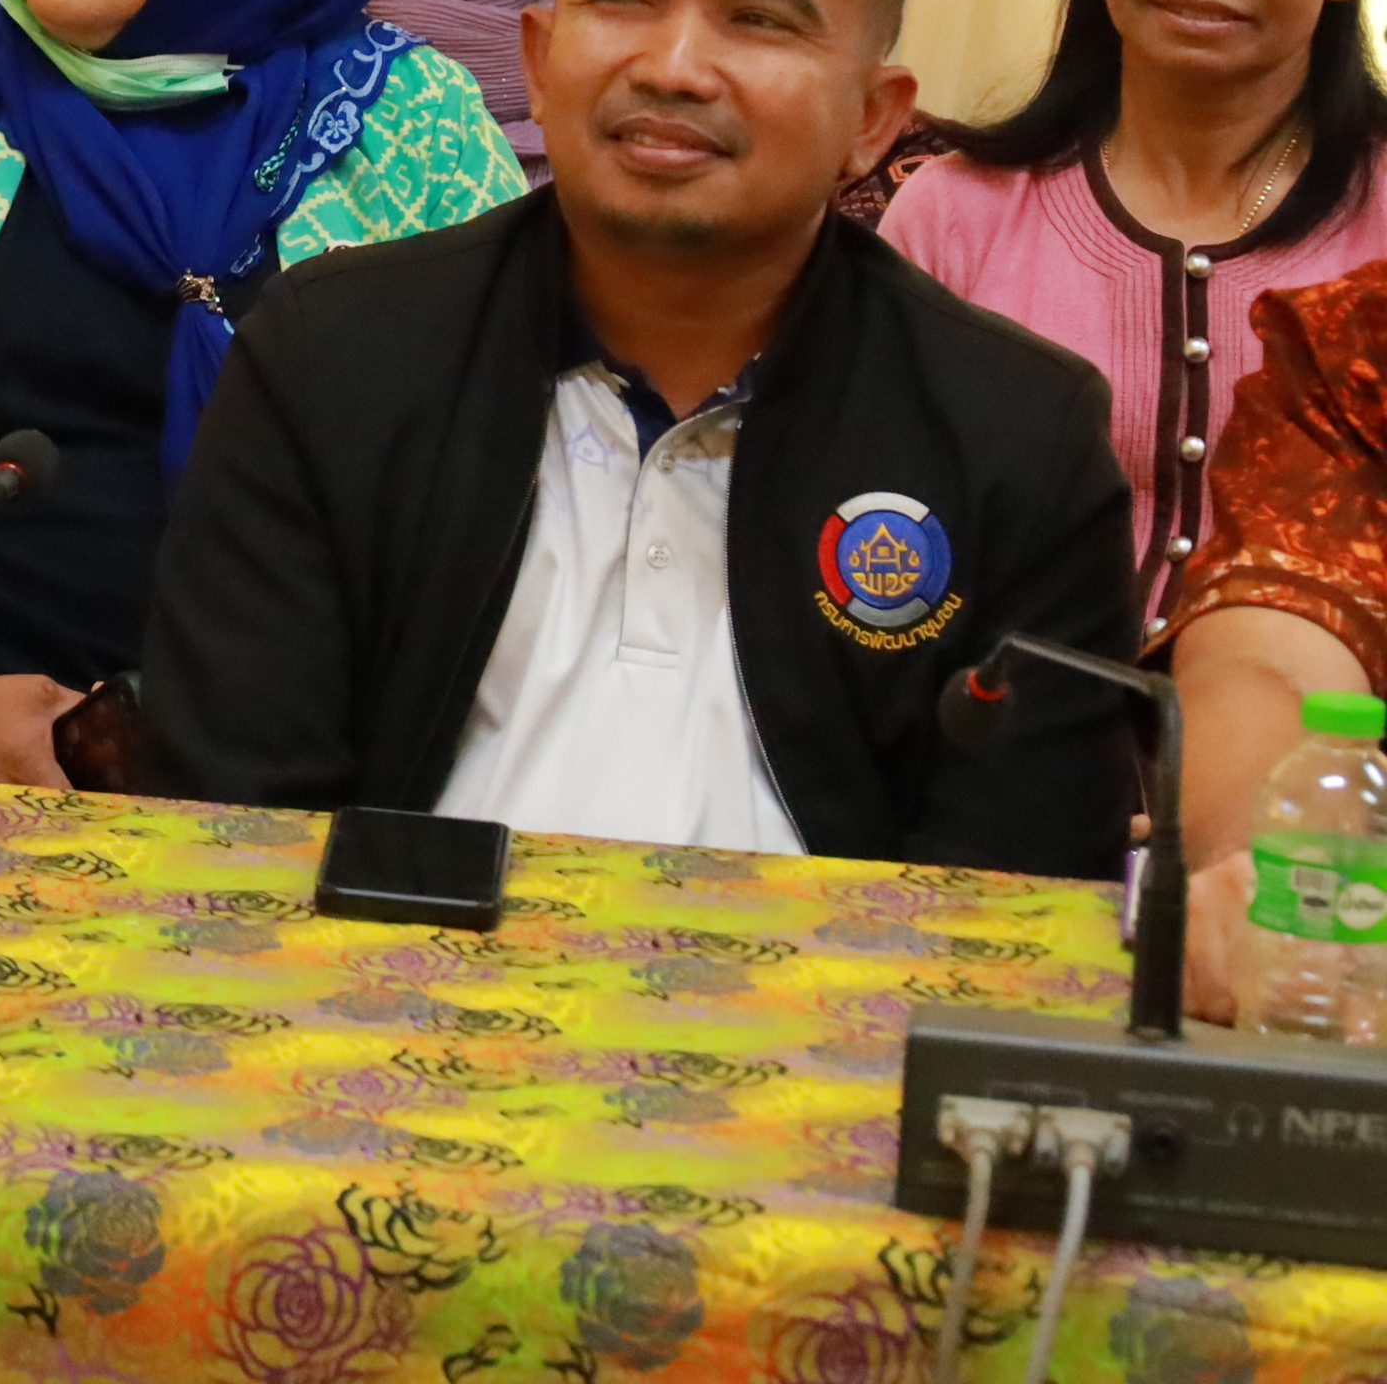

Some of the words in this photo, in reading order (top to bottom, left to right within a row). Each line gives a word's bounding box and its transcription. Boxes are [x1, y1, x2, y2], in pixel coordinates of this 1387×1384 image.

[813, 590, 964, 650] กรมการพัฒนาชุมชน
